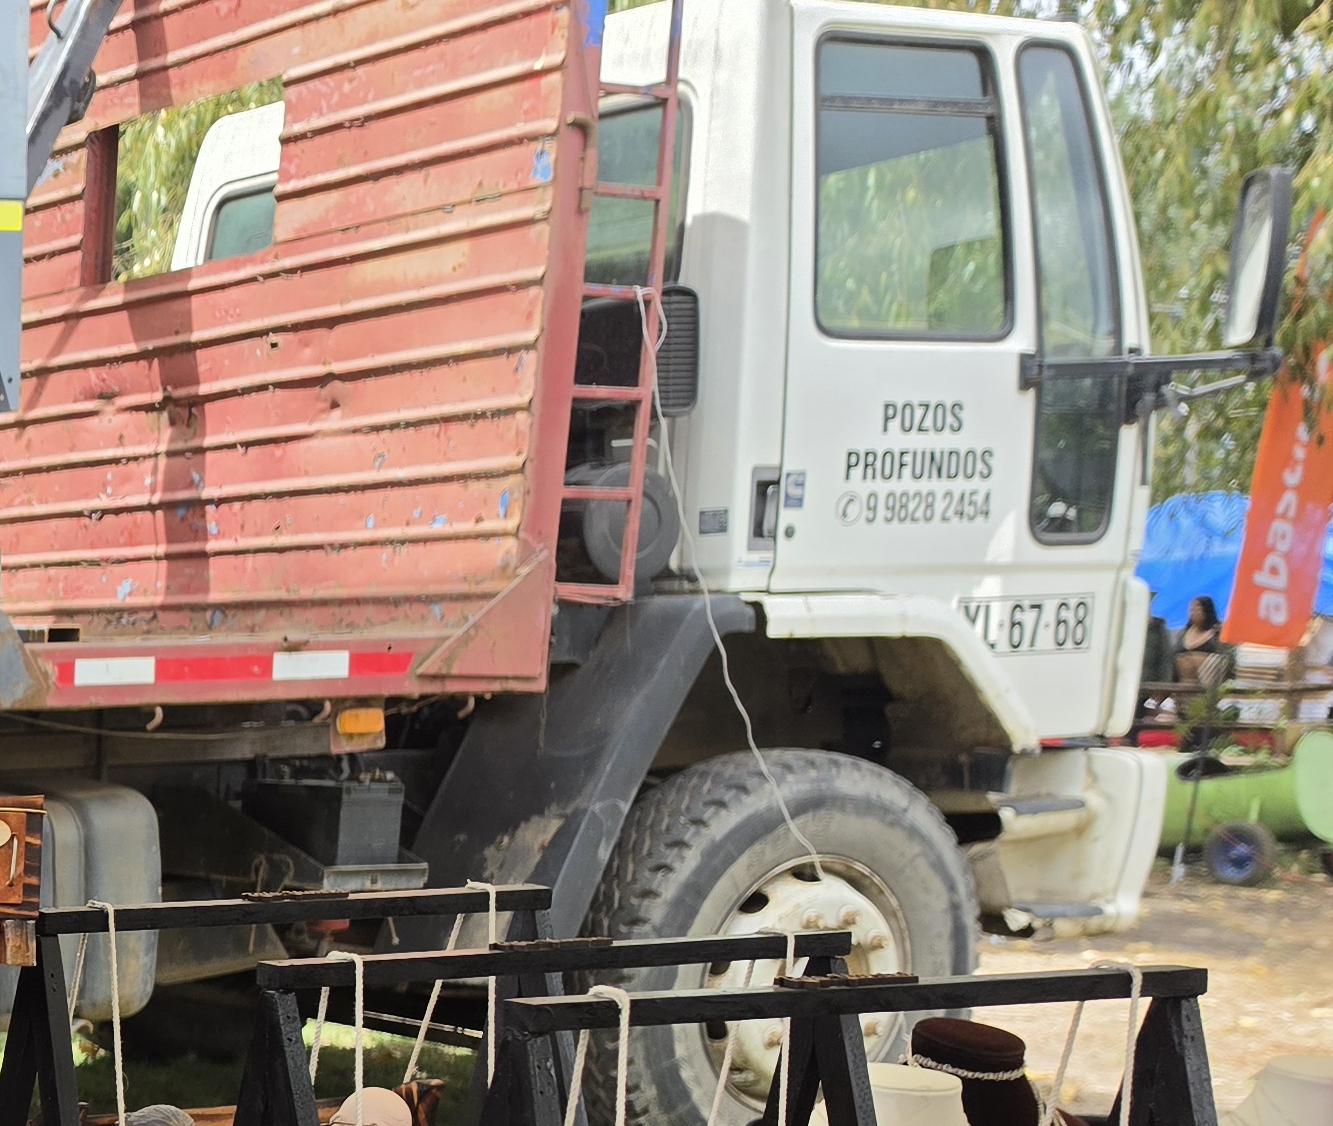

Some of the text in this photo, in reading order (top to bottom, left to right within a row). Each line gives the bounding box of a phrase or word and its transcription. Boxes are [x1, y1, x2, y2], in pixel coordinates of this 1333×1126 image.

[883, 402, 964, 433] POZOS
[844, 449, 995, 481] PROFUNDOS
[865, 488, 992, 523] 9 9828 2454
